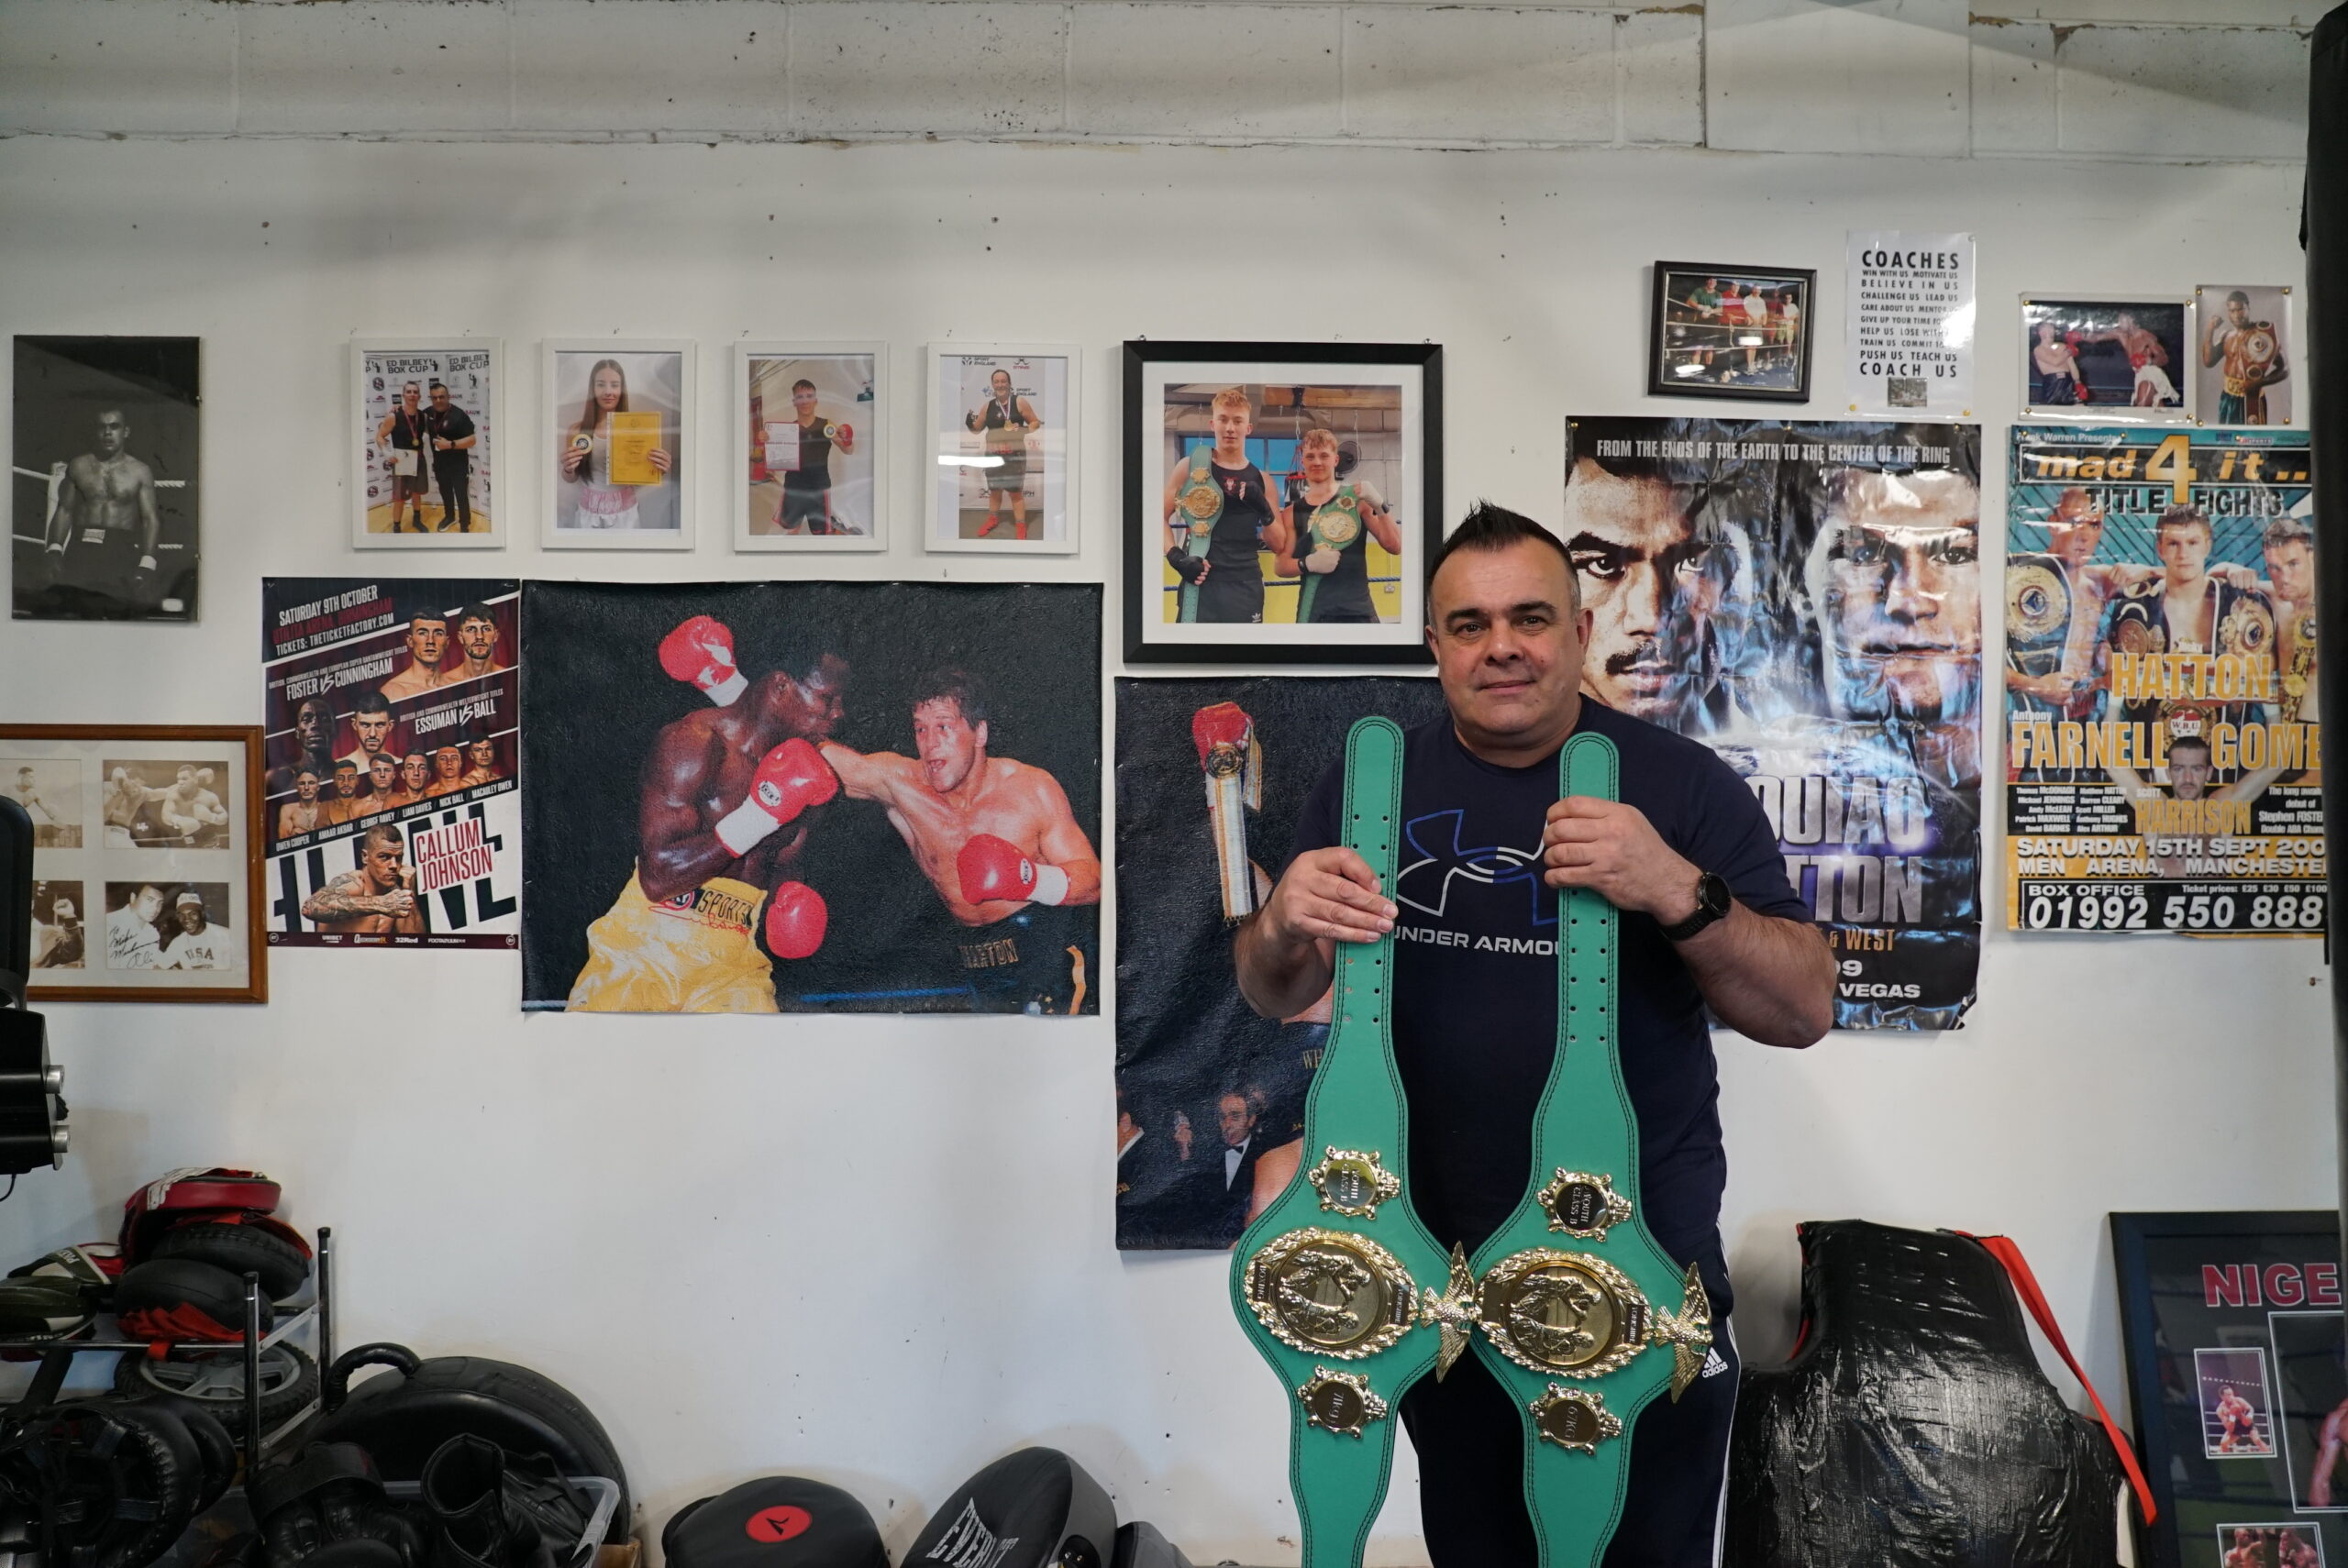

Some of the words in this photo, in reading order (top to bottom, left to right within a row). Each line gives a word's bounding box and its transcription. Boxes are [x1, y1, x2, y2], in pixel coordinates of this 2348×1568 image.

[1862, 250, 1958, 270] COACHES
[1862, 280, 1912, 288] BELIEVE
[1944, 282, 1957, 290] US
[1860, 350, 1886, 359] PUSH
[1891, 351, 1903, 359] US
[1911, 352, 1940, 361] TEACH
[1945, 353, 1957, 361] US
[1860, 362, 1921, 376] COACH
[1936, 365, 1956, 378] US
[1597, 440, 1632, 457] FROM
[1636, 440, 1657, 457] THE
[1662, 441, 1693, 458] ENDS
[1698, 441, 1711, 458] OF
[1716, 442, 1737, 458] THE
[1742, 443, 1778, 460] EARTH
[1783, 444, 1799, 460] TO
[1802, 444, 1824, 460] THE
[1828, 445, 1874, 461] CENTER
[1877, 445, 1892, 462] OF
[1896, 446, 1918, 463] THE
[1922, 447, 1950, 463] RING
[2036, 449, 2138, 479] mad
[2144, 434, 2197, 504] 4
[2086, 488, 2167, 516] TITLE
[2194, 489, 2284, 517] FIGHTS
[279, 601, 322, 626] SATURDAY
[324, 596, 339, 613] 9TH
[341, 585, 378, 609] OCTOBER
[276, 637, 308, 656] TICKETS:
[310, 613, 394, 646] THETICKETFACTORY.COM
[286, 678, 318, 701] FOSTER
[320, 673, 335, 695] VS
[335, 657, 393, 688] CUNNINGHAM
[2111, 652, 2272, 701] HATTON
[415, 709, 457, 734] ESSUMAN
[459, 704, 473, 726] VS
[474, 699, 496, 719] BALL
[2012, 710, 2052, 722] Anthony
[2011, 721, 2170, 768] FARNELL
[2269, 787, 2281, 795] The
[2283, 787, 2298, 796] long
[415, 801, 432, 814] DAVIES
[439, 797, 452, 808] NICK
[452, 794, 464, 805] BALL
[2286, 799, 2306, 808] debut
[2308, 800, 2316, 808] of
[2037, 814, 2071, 823] MAXWELL
[2135, 800, 2252, 834] HARRISON
[2259, 811, 2295, 823] Stephen
[2261, 824, 2286, 834] Double
[2287, 824, 2301, 834] ABA
[415, 819, 481, 864] CALLUM
[2018, 837, 2140, 858] SATURDAY
[2146, 838, 2202, 858] 15TH
[2209, 838, 2270, 858] SEPT
[422, 845, 493, 892] JOHNSON
[2019, 858, 2066, 877] MEN
[2086, 858, 2165, 878] ARENA,
[2028, 885, 2069, 896] BOX
[2076, 885, 2144, 896] OFFICE
[2182, 885, 2207, 893] Ticket
[2210, 885, 2238, 894] prices:
[2242, 885, 2258, 893] £25
[2263, 885, 2279, 893] £30
[2284, 885, 2300, 893] £50
[2029, 896, 2148, 929] 01992
[2163, 895, 2235, 928] 550
[2250, 895, 2323, 928] 888
[1474, 935, 1558, 956] ARMO
[1829, 931, 1838, 948] &
[1845, 929, 1895, 951] WEST
[184, 947, 215, 960] USA
[1838, 983, 1921, 999] VEGAS
[1571, 1187, 1581, 1218] CLASS
[1581, 1193, 1590, 1222] YOUTH
[1257, 1265, 1267, 1300] BOXING
[2201, 1263, 2342, 1308] NIGE
[1701, 1360, 1728, 1378] adidas
